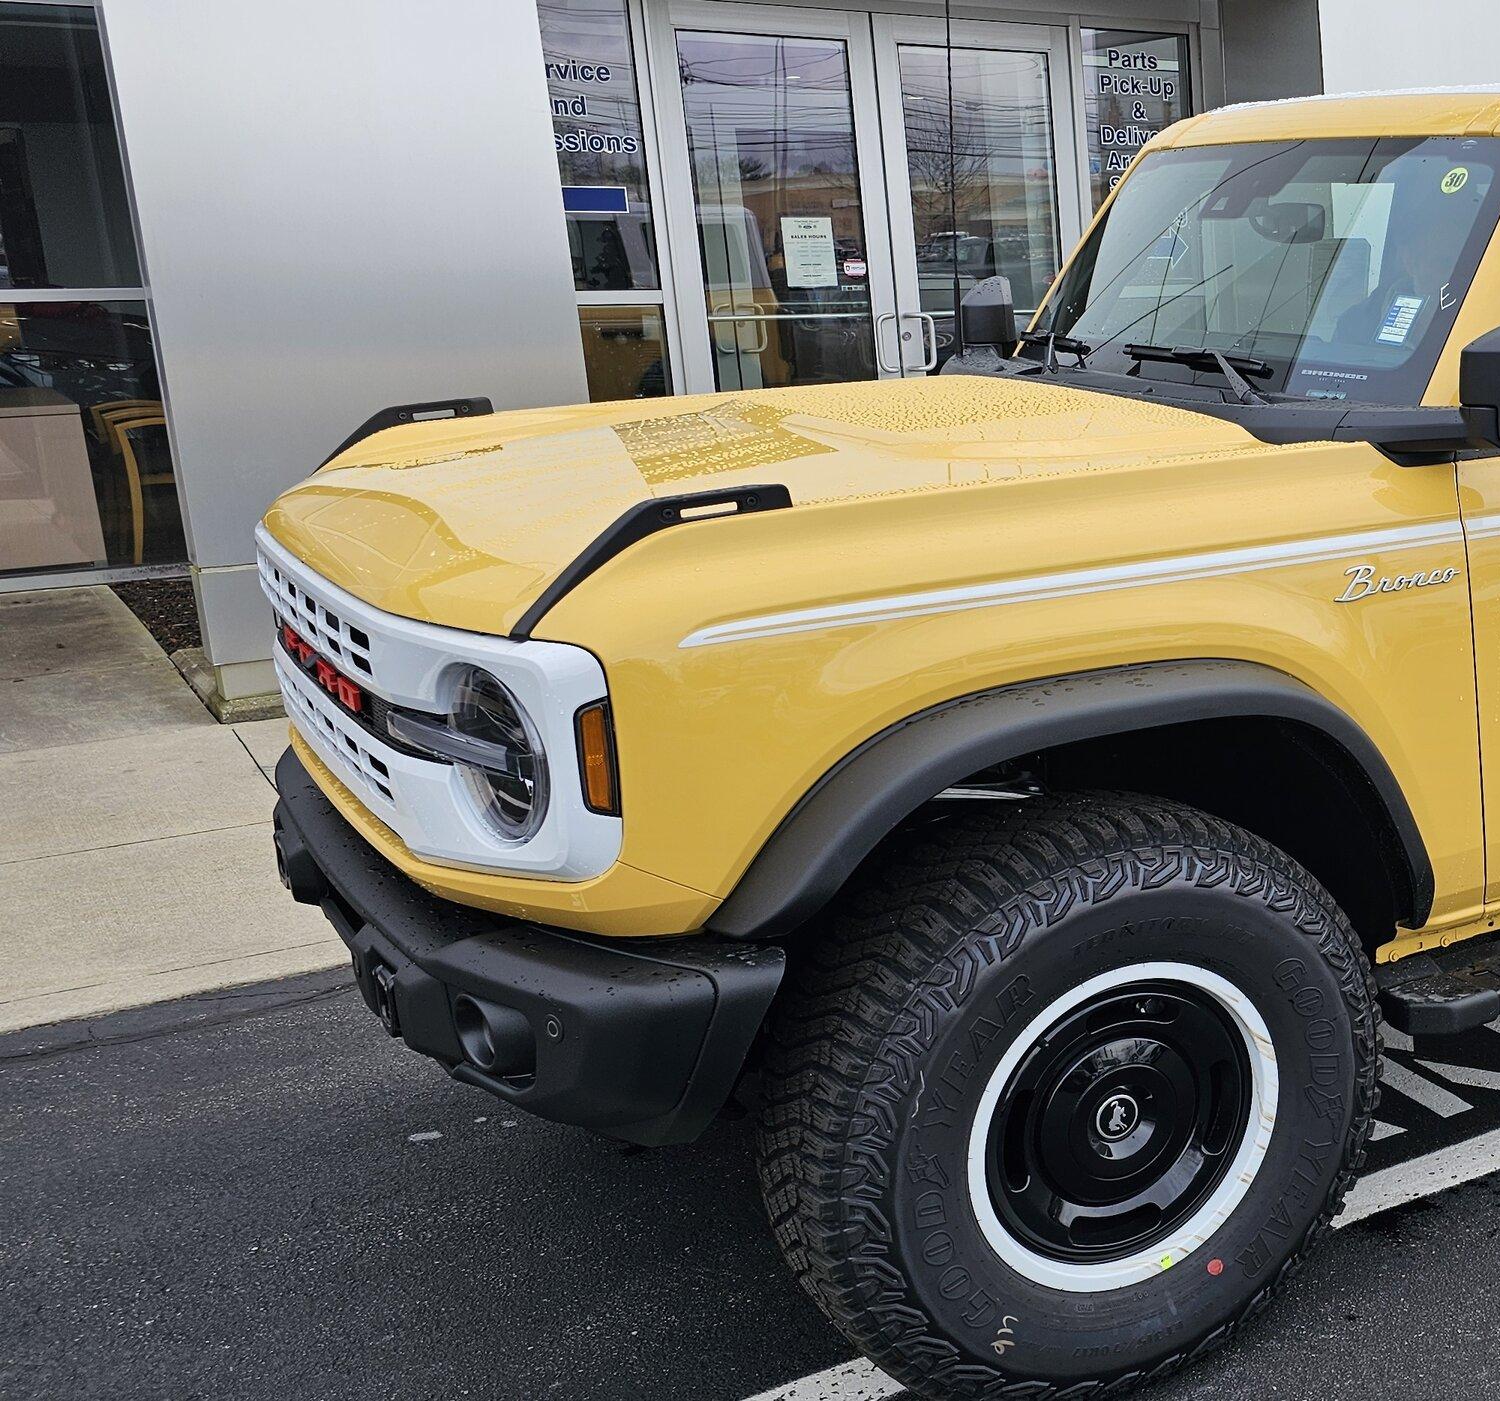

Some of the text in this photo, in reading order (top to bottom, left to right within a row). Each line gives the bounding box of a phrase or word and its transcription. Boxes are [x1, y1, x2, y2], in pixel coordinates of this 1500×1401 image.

[1107, 49, 1158, 70] Parts
[1099, 75, 1174, 100] Pick-Up
[550, 95, 587, 117] nd
[1132, 101, 1148, 120] &
[1445, 172, 1467, 188] 30
[1440, 282, 1457, 311] E
[1301, 369, 1368, 381] BRONCO
[1334, 565, 1461, 602] Bronco
